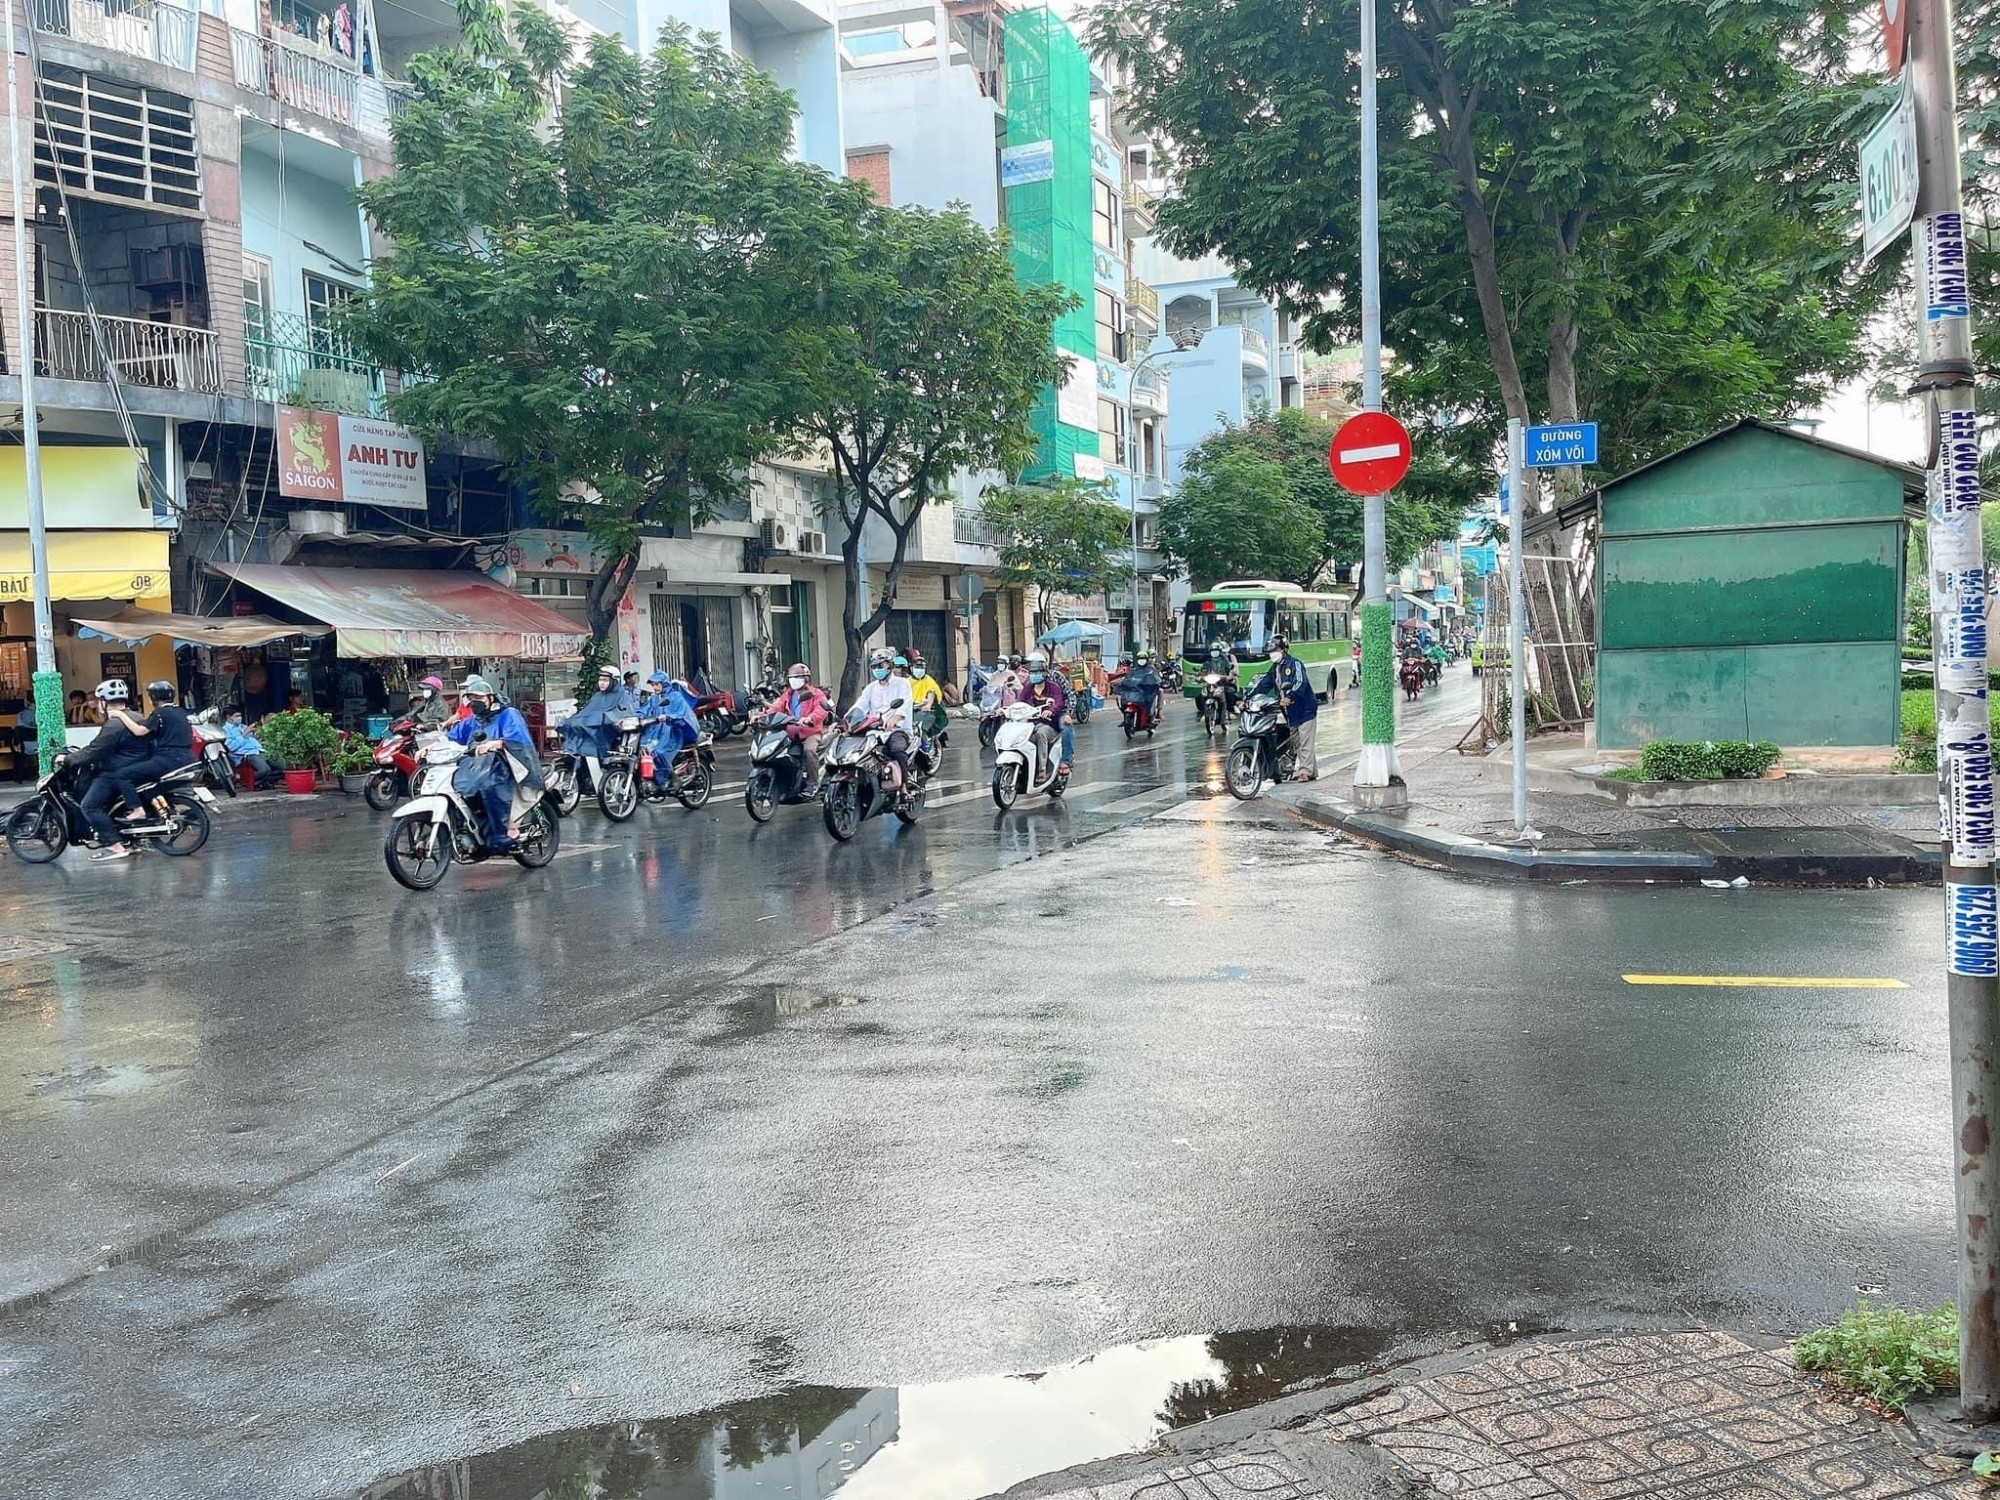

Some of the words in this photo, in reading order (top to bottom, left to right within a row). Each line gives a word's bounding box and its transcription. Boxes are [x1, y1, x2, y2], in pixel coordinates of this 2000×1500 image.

[1540, 430, 1582, 442] ĐƯỜNG
[348, 444, 389, 466] ANH
[392, 450, 418, 470] TƯ
[1536, 445, 1561, 462] XÓM
[1566, 445, 1585, 460] VÔI
[302, 466, 318, 474] BIA
[286, 472, 336, 489] SAIGON
[423, 645, 474, 656] SAIGON
[1956, 886, 1996, 911] 229
[1955, 912, 1996, 939] 255
[1954, 941, 1996, 974] 0906
